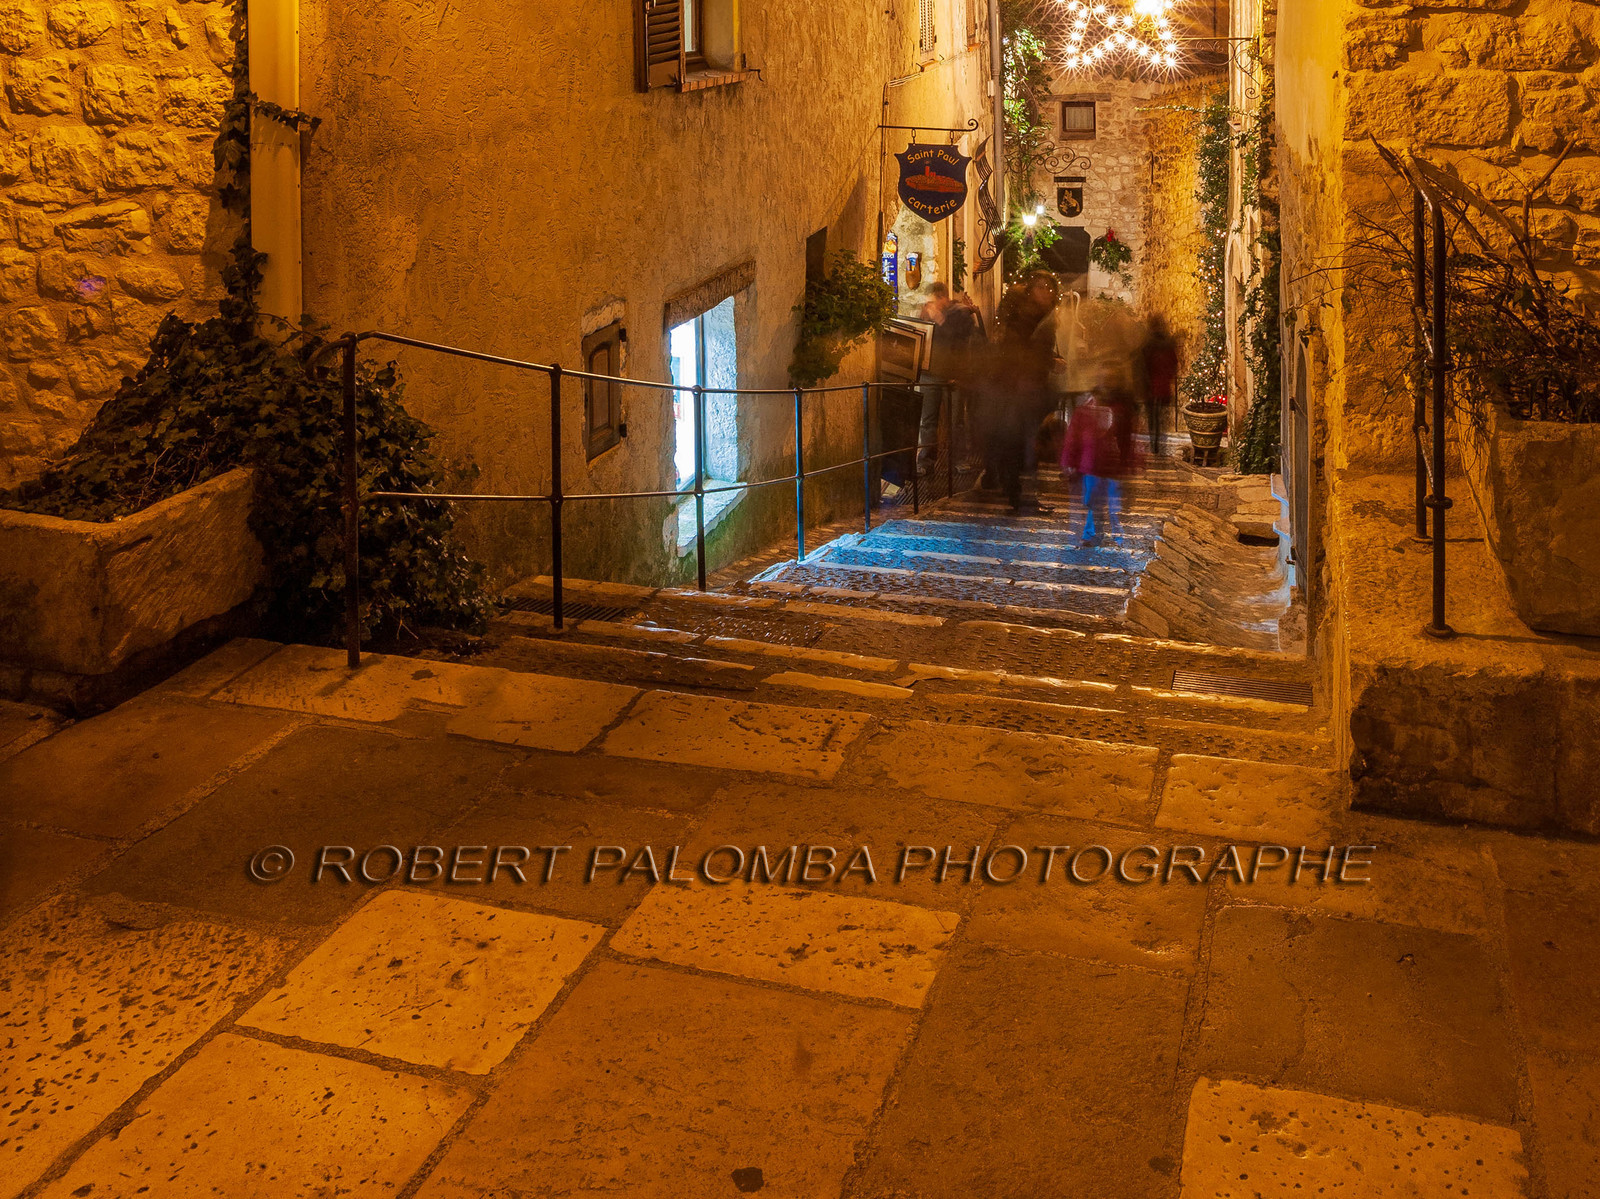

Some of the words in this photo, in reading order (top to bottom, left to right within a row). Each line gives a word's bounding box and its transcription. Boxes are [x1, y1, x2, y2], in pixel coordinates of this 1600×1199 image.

[907, 149, 934, 164] Saint
[937, 149, 960, 166] Paul
[907, 196, 957, 215] carterie
